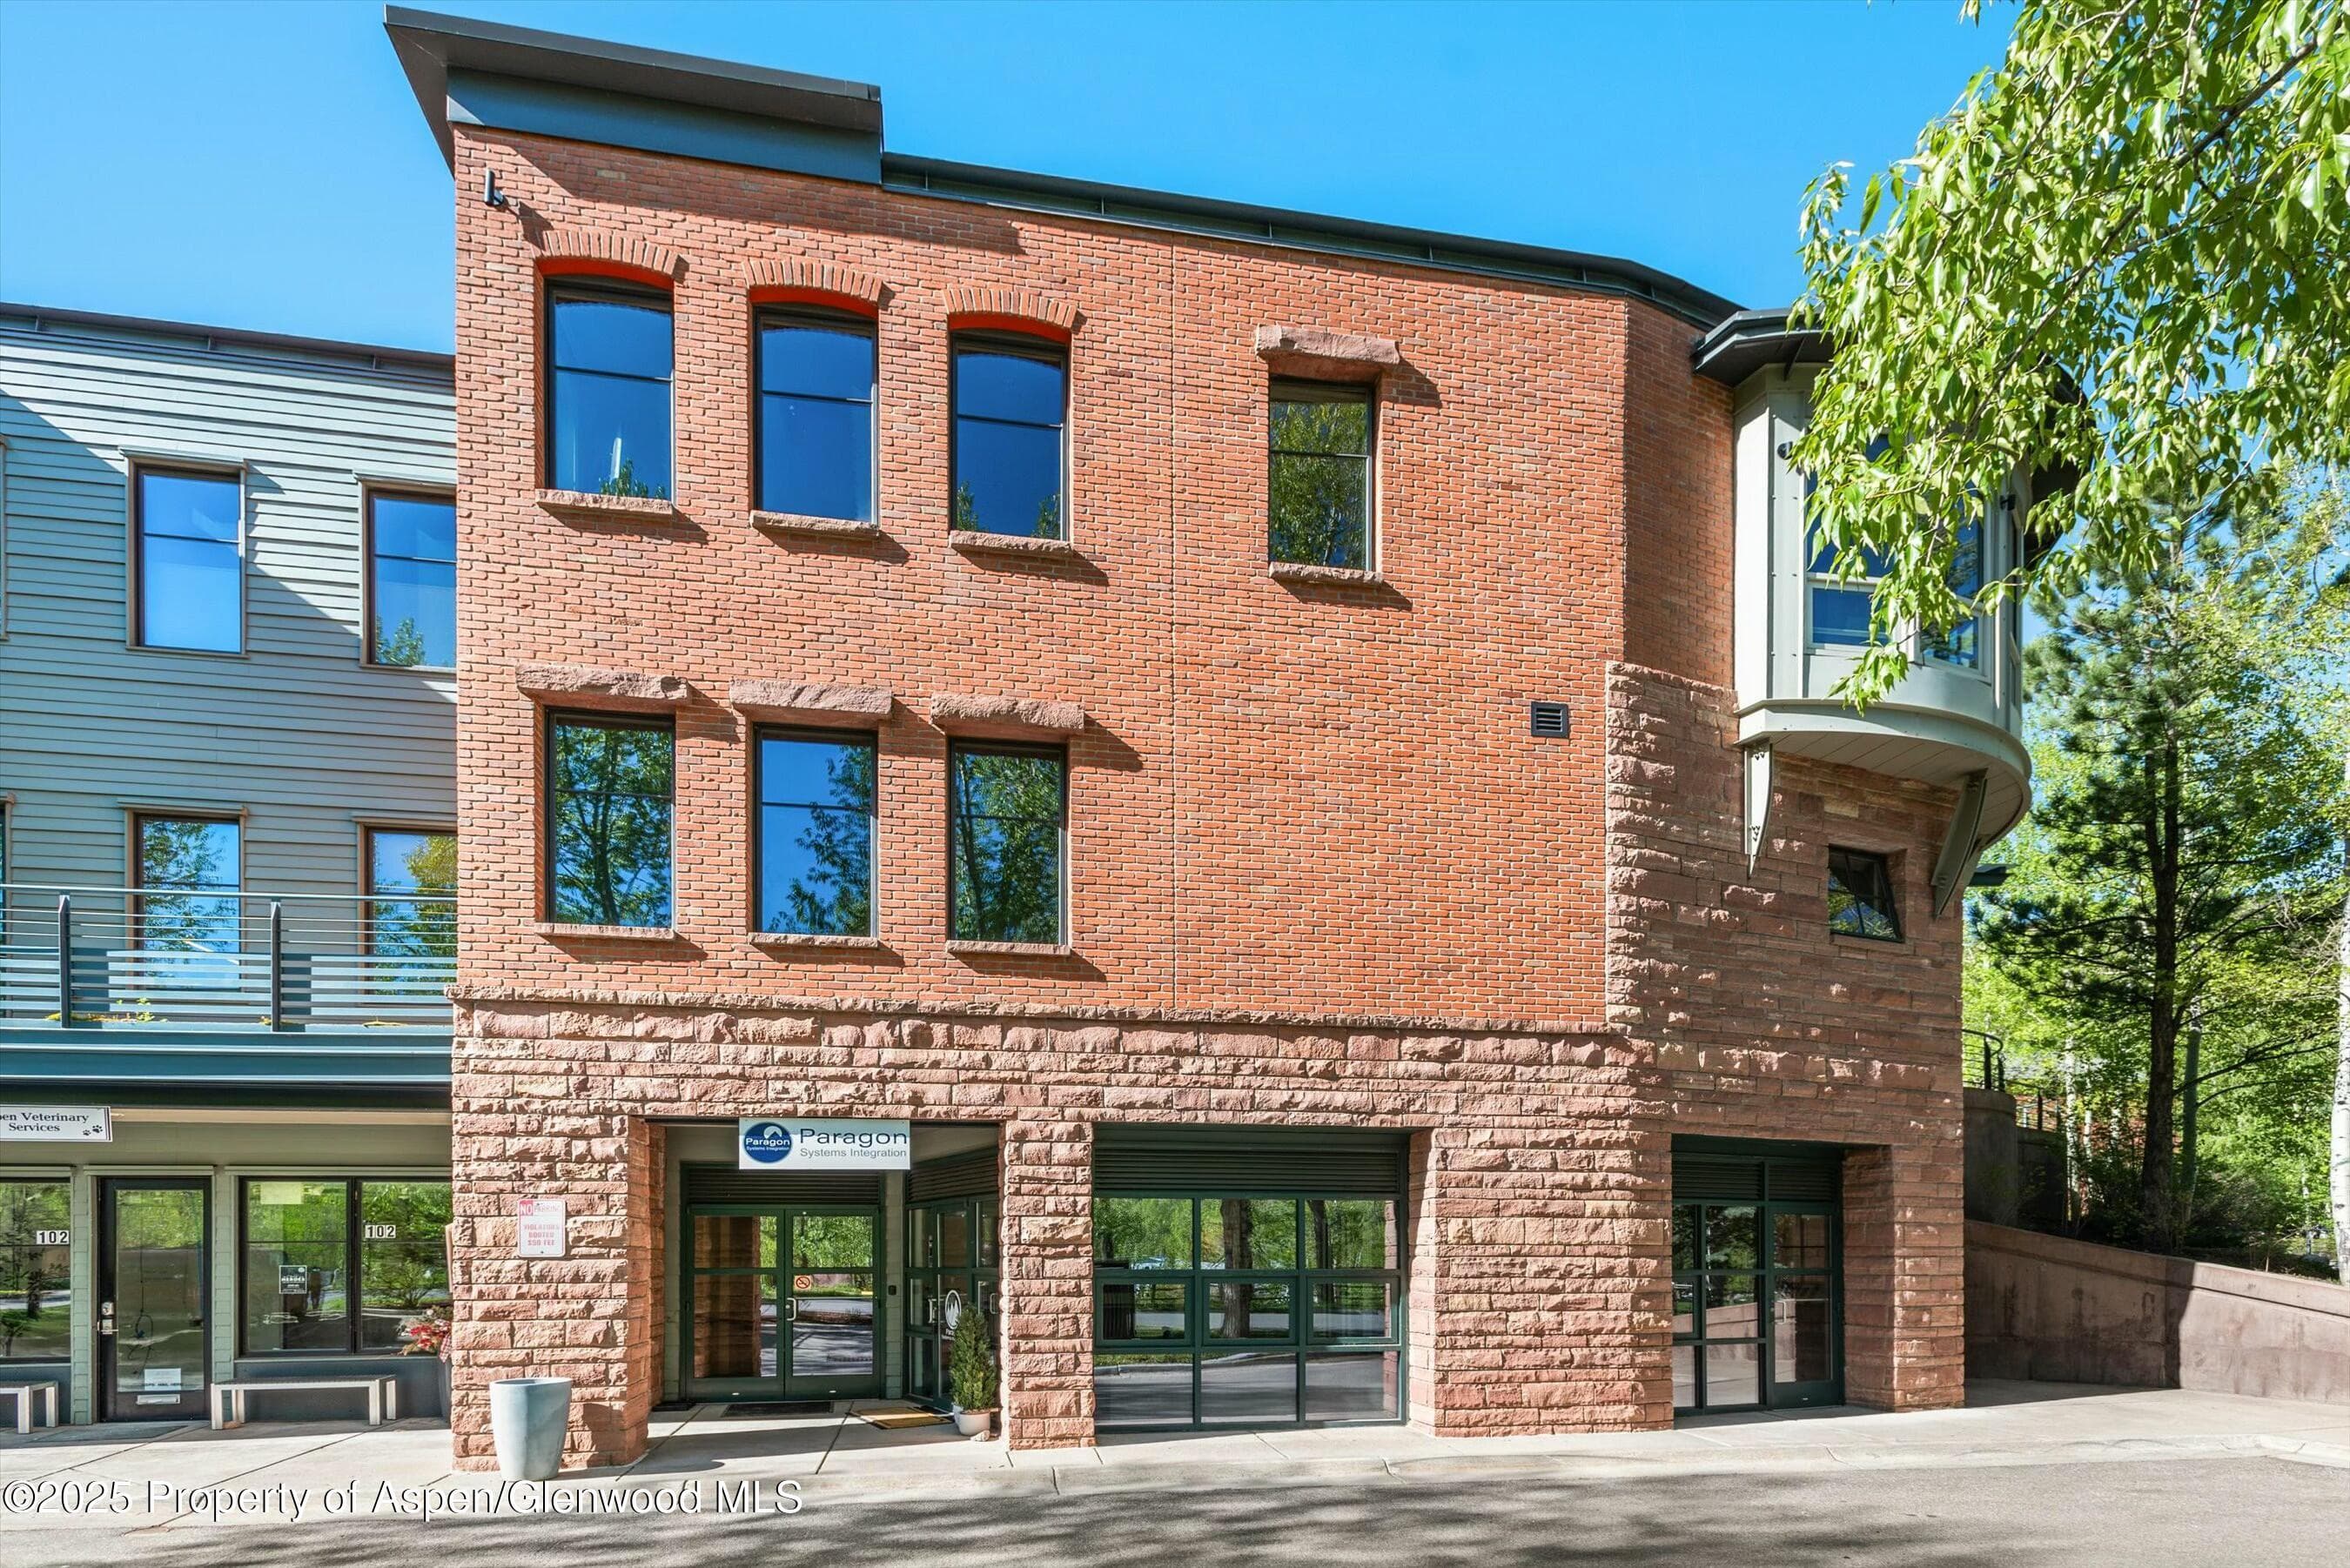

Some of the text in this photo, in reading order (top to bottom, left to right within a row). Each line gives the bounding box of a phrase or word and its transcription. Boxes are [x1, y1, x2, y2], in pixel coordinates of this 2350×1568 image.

[21, 1113, 89, 1123] Veterinary
[9, 1122, 61, 1132] Services
[745, 1137, 790, 1147] Paragon
[800, 1128, 907, 1149] Paragon
[800, 1148, 907, 1159] Systems Integration
[520, 1203, 533, 1215] NO
[38, 1230, 68, 1243] 102
[366, 1225, 395, 1237] 102
